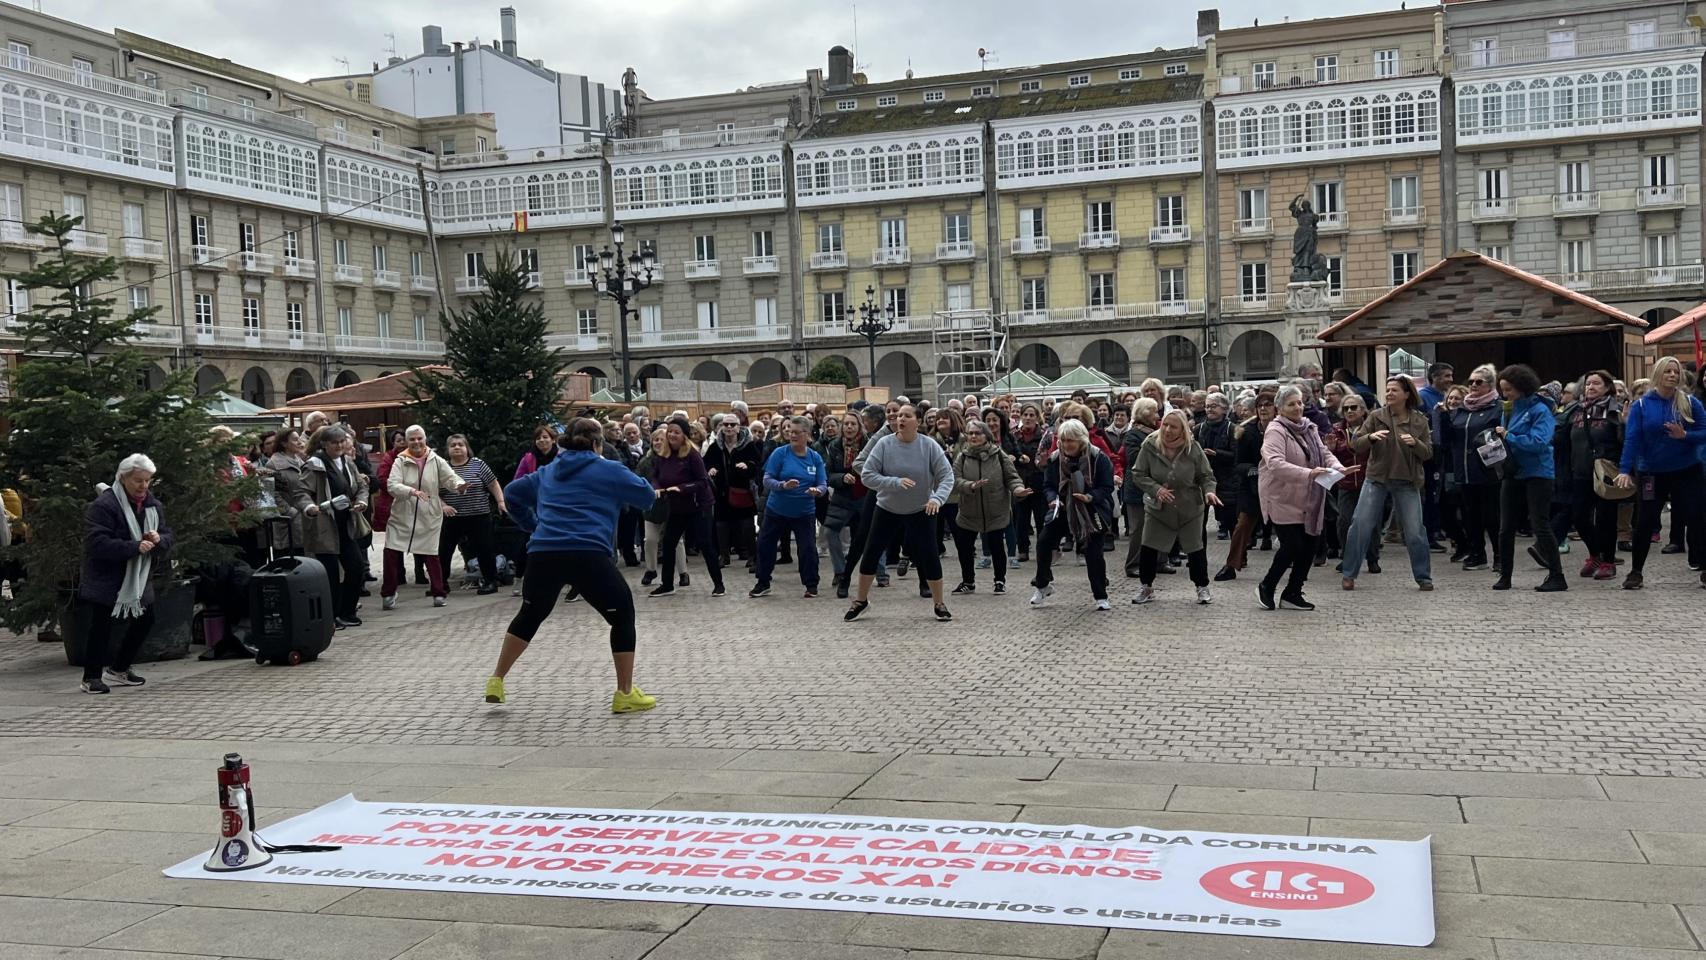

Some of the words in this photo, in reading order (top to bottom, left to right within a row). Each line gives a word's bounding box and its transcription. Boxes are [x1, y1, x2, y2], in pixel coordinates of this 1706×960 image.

[379, 808, 524, 819] ESCOLAS
[523, 812, 729, 826] DEPORTIVAS
[730, 818, 929, 833] MUNICIPAIS
[934, 826, 1134, 842] CONCELLO
[1139, 833, 1194, 846] DA
[384, 821, 486, 835] POR
[487, 824, 566, 838] UN
[561, 827, 781, 845] SERVIZO
[783, 834, 864, 849] DE
[866, 838, 1154, 864] CALIDADE
[309, 833, 511, 850] MELLORAS
[511, 841, 719, 859] LABORAIS
[719, 850, 755, 860] E
[754, 850, 977, 870] SALARIOS
[980, 860, 1163, 881] DIGNOS
[422, 853, 614, 873] NOVOS
[608, 860, 845, 883] PREGOS
[848, 871, 960, 889] XA!
[264, 865, 313, 876] Na
[313, 868, 447, 882] defensa
[446, 874, 509, 886] dos
[511, 878, 620, 892] nosos
[622, 882, 774, 900] dereitos
[808, 891, 879, 903] dos
[883, 895, 1056, 914] usuarios
[1063, 907, 1089, 916] e
[1096, 908, 1283, 928] usuarias
[1250, 891, 1318, 901] ENSINO
